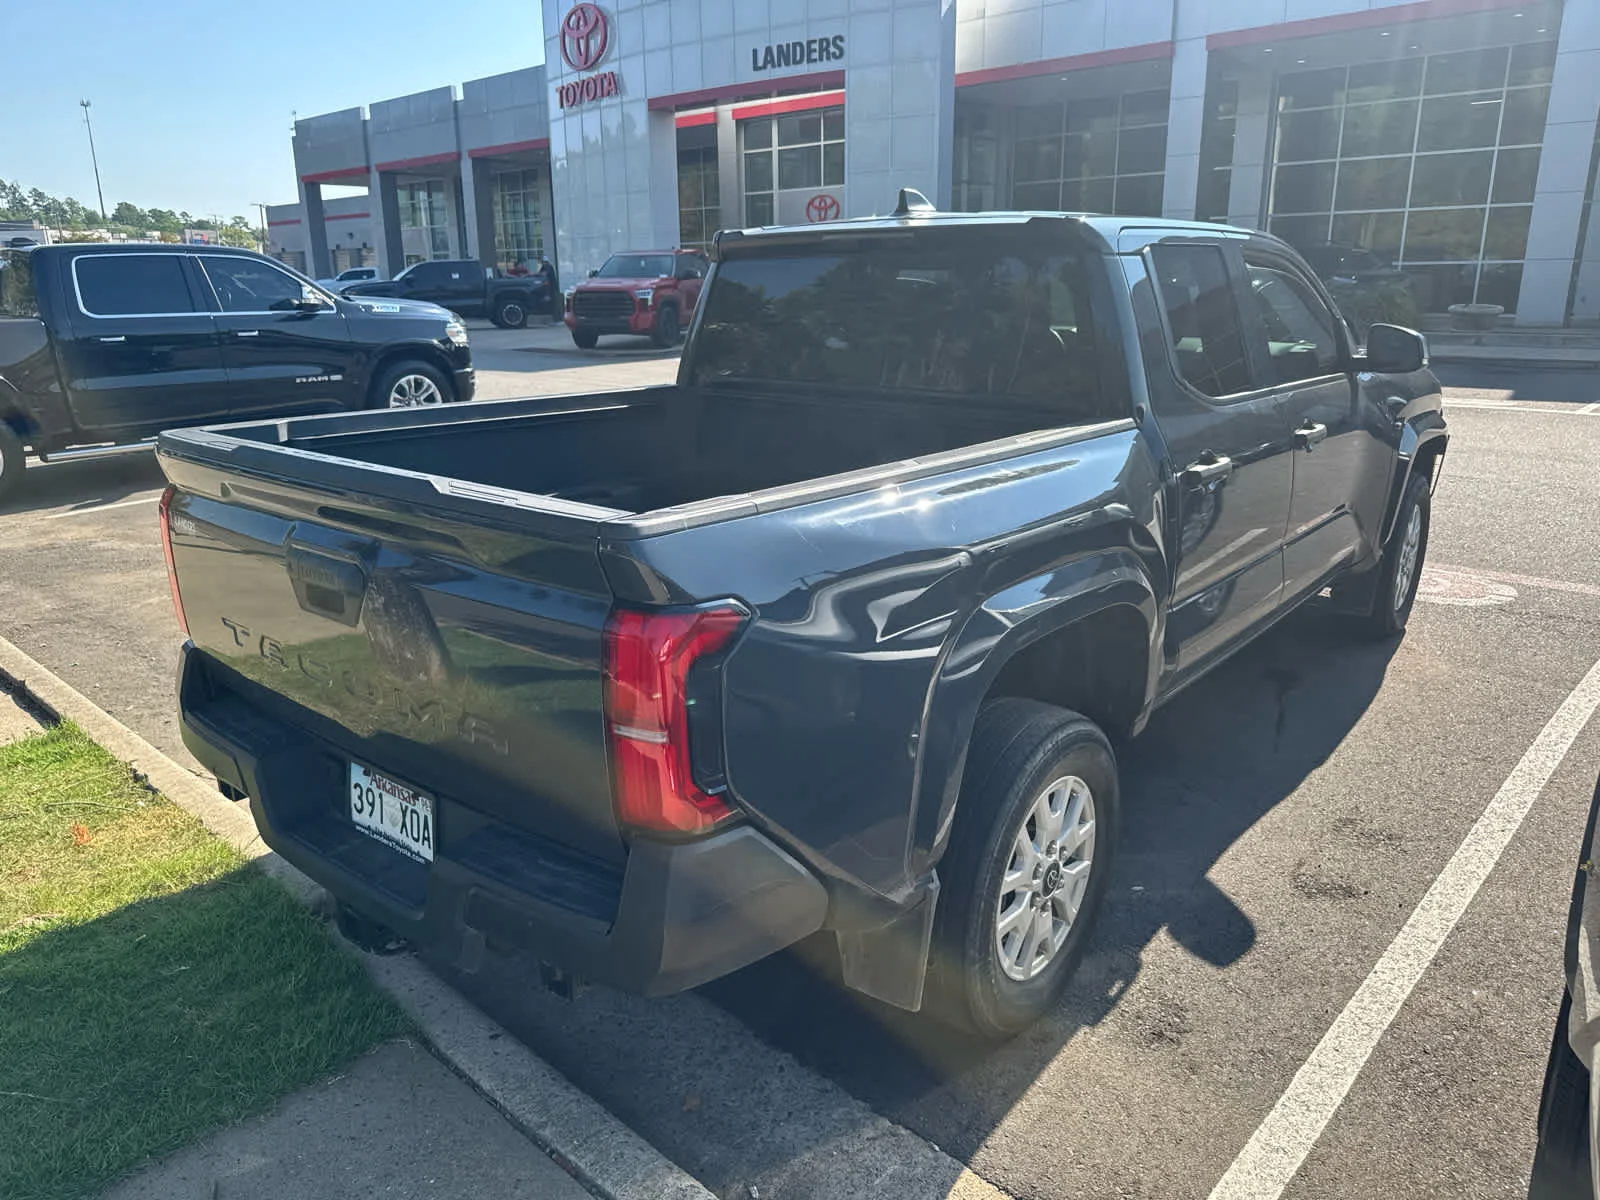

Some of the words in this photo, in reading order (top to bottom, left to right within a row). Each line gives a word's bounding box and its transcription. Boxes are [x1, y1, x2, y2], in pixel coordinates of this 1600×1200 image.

[752, 35, 845, 72] LANDERS
[556, 71, 619, 109] TOYOTA
[296, 375, 329, 384] RAM
[353, 782, 384, 825] 391
